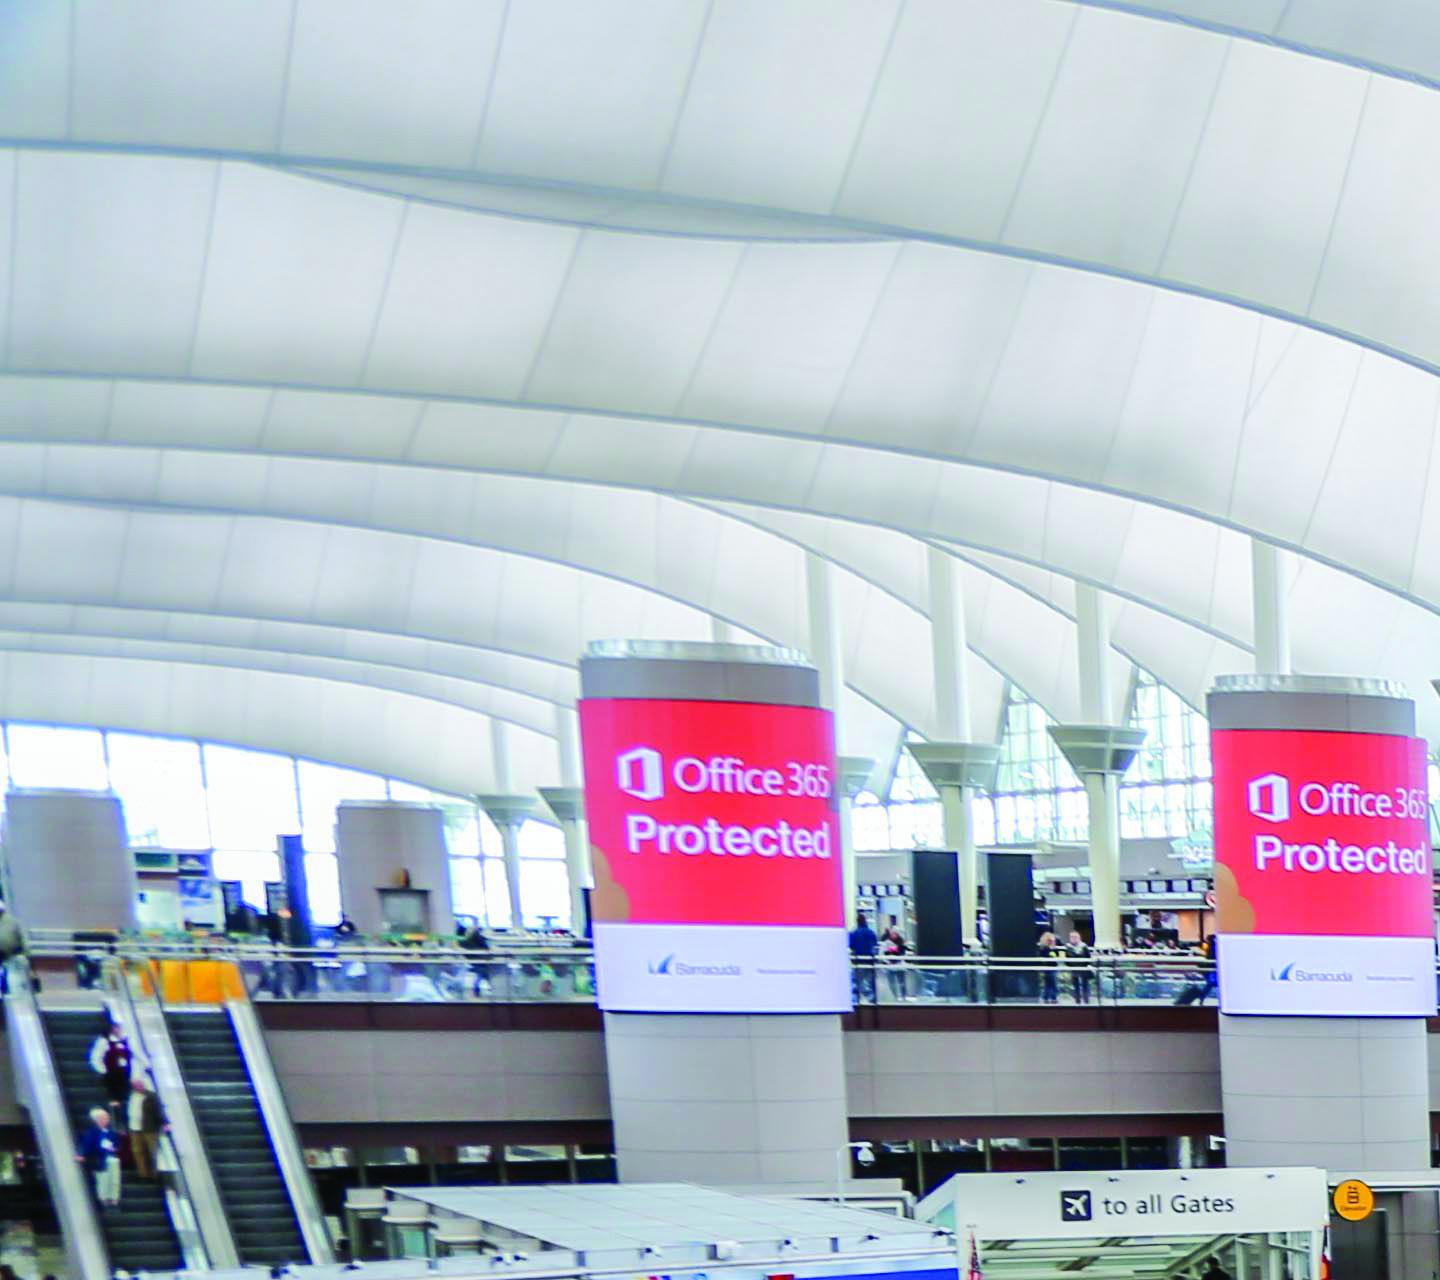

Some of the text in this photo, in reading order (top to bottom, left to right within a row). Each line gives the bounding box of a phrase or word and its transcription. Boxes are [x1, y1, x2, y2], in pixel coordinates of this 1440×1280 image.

[672, 756, 831, 799] Office 365
[1298, 782, 1428, 821] Office 365
[625, 812, 832, 859] Protected
[1253, 834, 1428, 875] Protected
[1294, 968, 1354, 983] Barracuda
[1102, 1193, 1235, 1215] to all Gates
